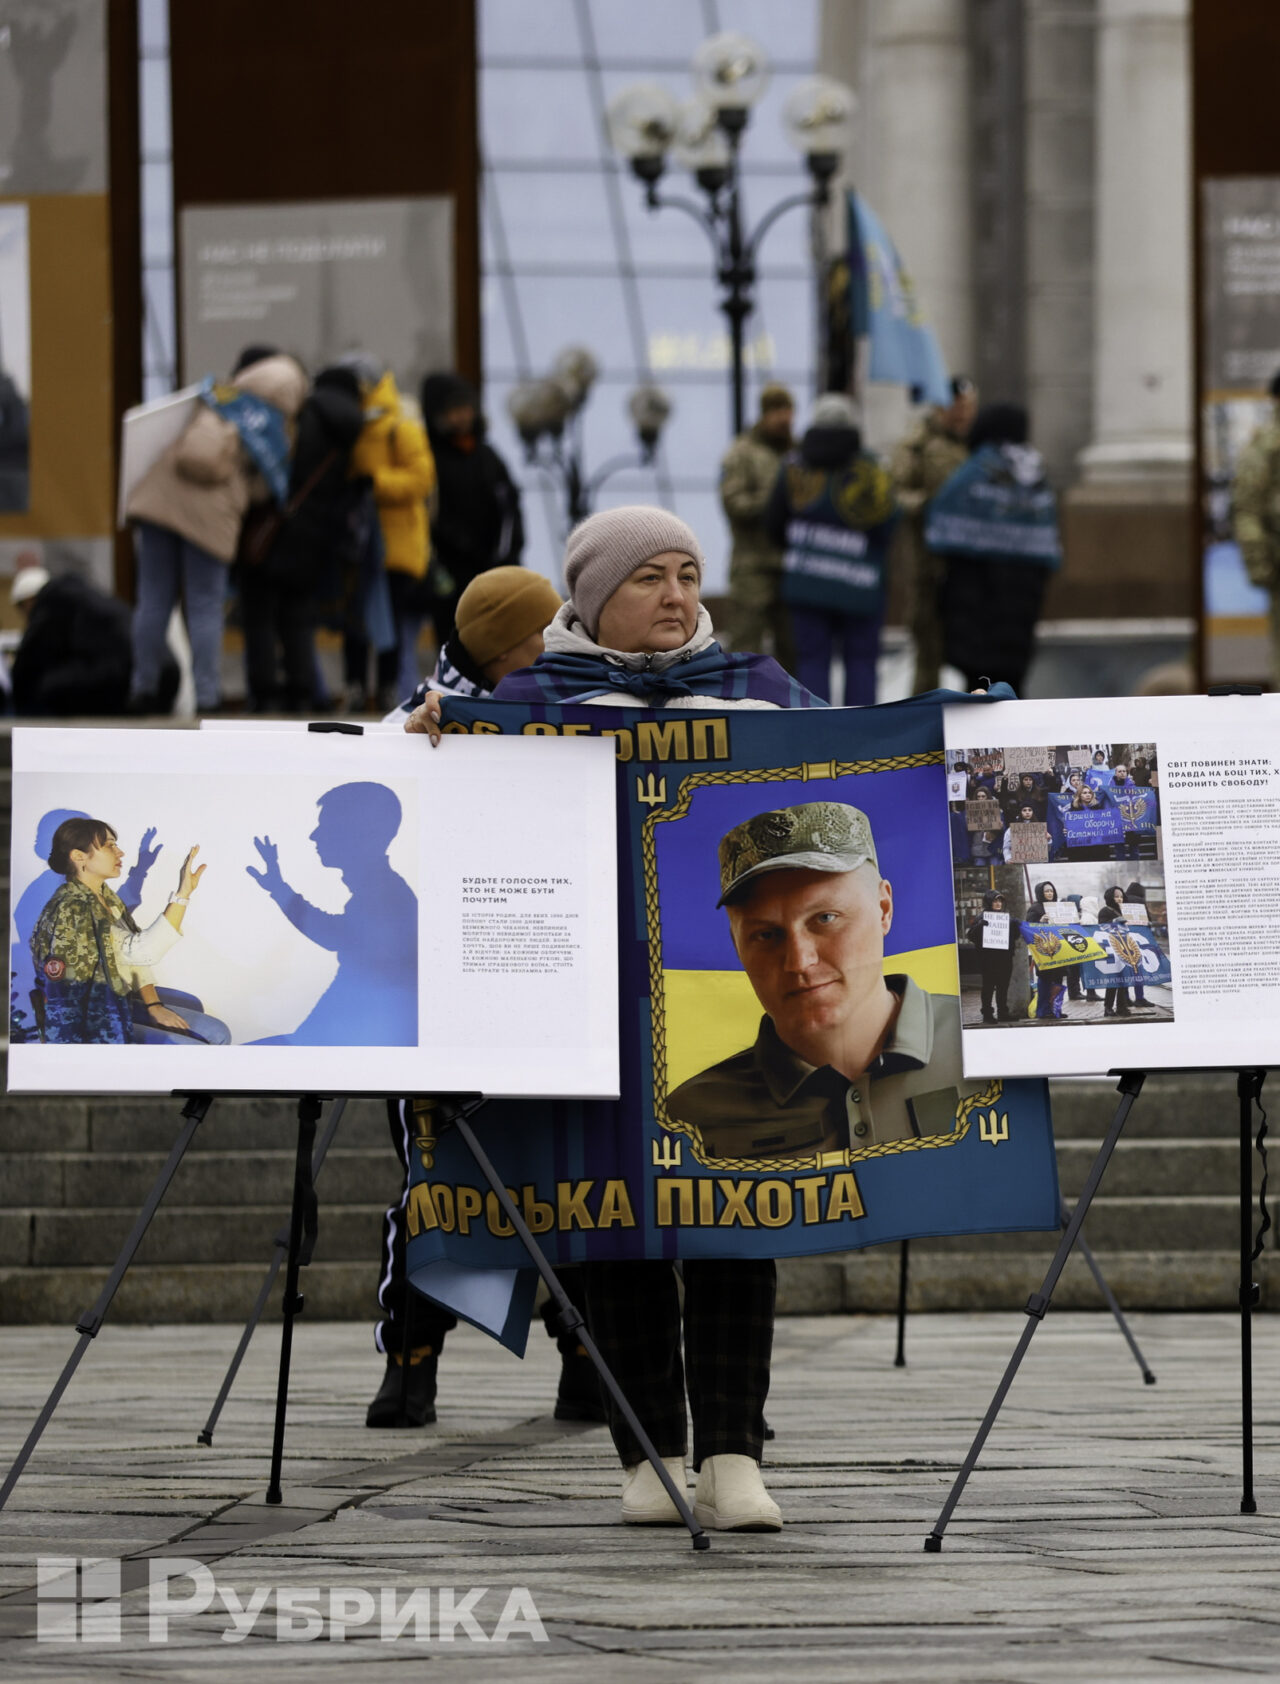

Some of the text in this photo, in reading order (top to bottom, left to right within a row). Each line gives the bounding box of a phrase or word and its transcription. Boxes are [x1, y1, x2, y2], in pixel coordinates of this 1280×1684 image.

[1221, 779, 1268, 787] СВОБОДУ!
[1065, 812, 1094, 820] Перший
[1093, 930, 1160, 974] 36
[655, 1172, 867, 1229] ПІХОТА
